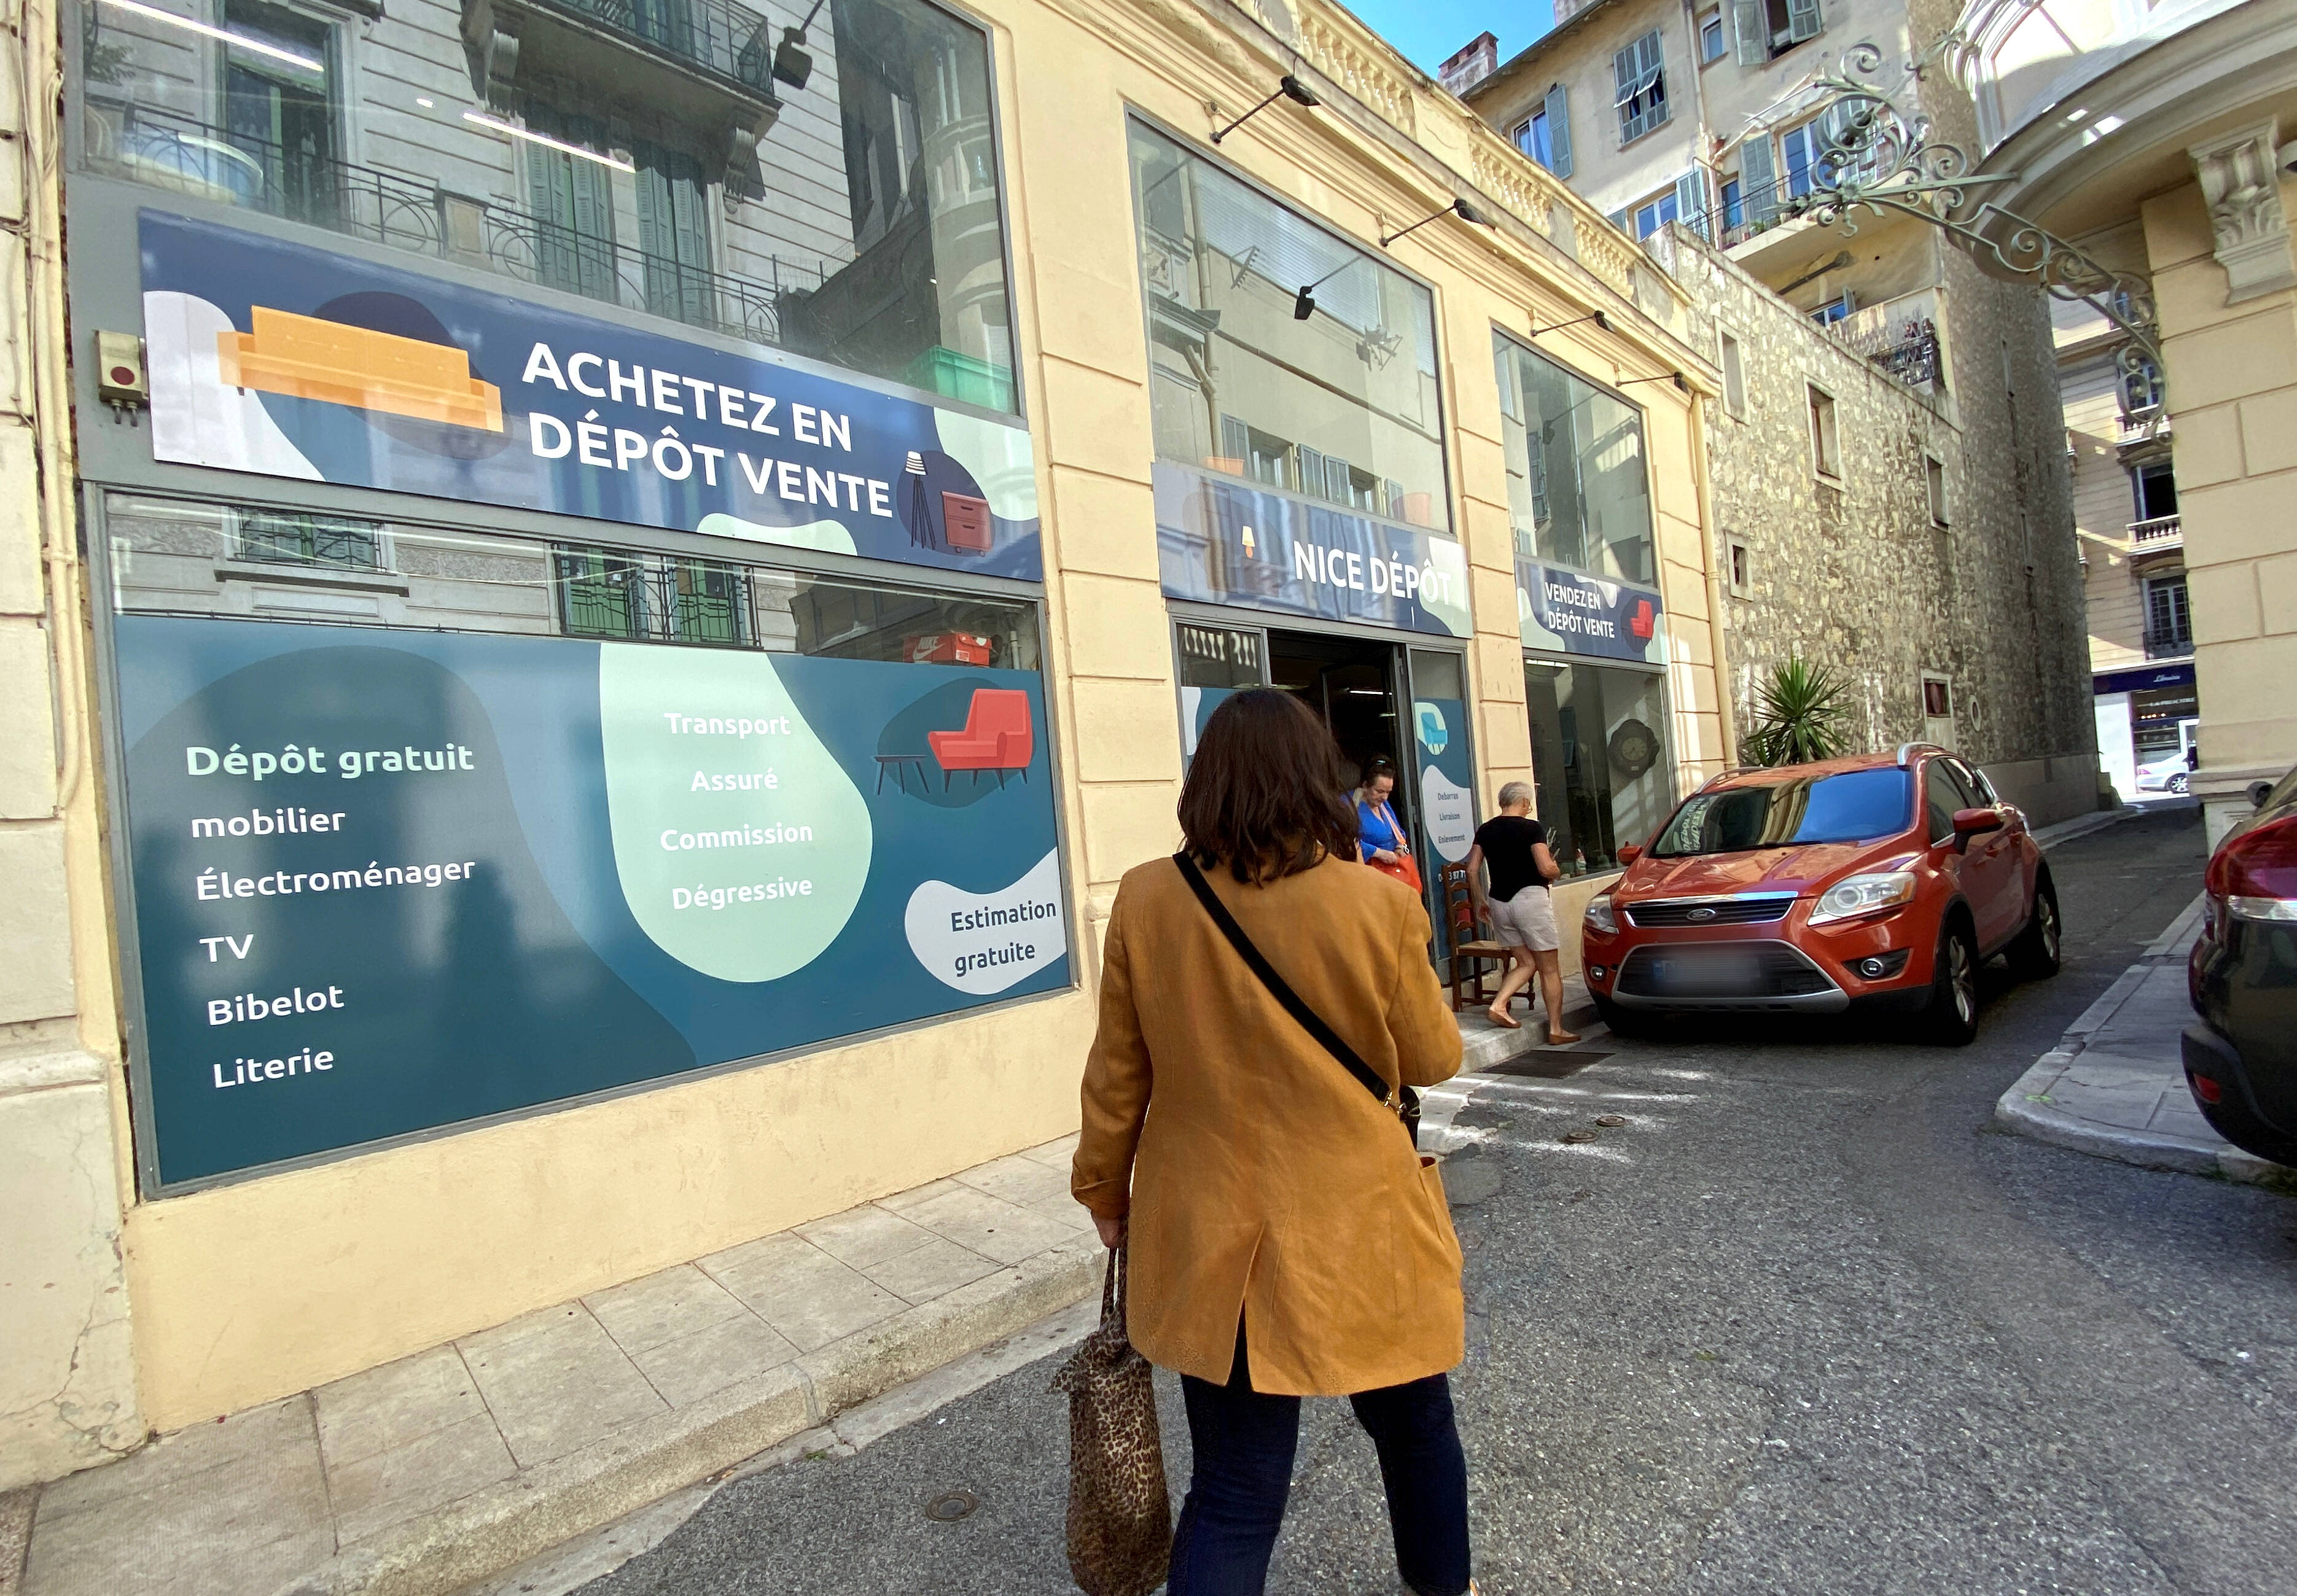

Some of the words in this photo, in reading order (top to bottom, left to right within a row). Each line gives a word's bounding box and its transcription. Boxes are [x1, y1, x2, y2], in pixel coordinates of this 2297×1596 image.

[522, 342, 779, 435] ACHETEZ
[792, 403, 852, 452] EN
[529, 410, 724, 486] DÉPÔT
[738, 452, 894, 518] VENTE
[1293, 540, 1364, 591] NICE
[1370, 550, 1452, 605] DÉPÔT
[1545, 582, 1587, 608] VENDEZ
[1588, 591, 1601, 610] EN
[1548, 606, 1582, 633] DÉPÔT
[1583, 617, 1615, 639] VENTE
[917, 636, 939, 650] NIKE
[664, 712, 790, 739] Transport
[186, 744, 326, 781] Dépôt
[339, 744, 475, 779] gratuit
[690, 767, 778, 792] Assuré
[192, 808, 346, 838] mobilier
[1440, 812, 1460, 821] Livraison
[660, 822, 813, 851] Commission
[197, 860, 476, 901] Électroménager
[672, 876, 813, 911] Dégressive
[951, 900, 1057, 932] Estimation
[200, 933, 254, 963] TV
[954, 941, 1035, 977] gratuite
[208, 985, 345, 1026] Bibelot
[213, 1048, 334, 1089] Literie
